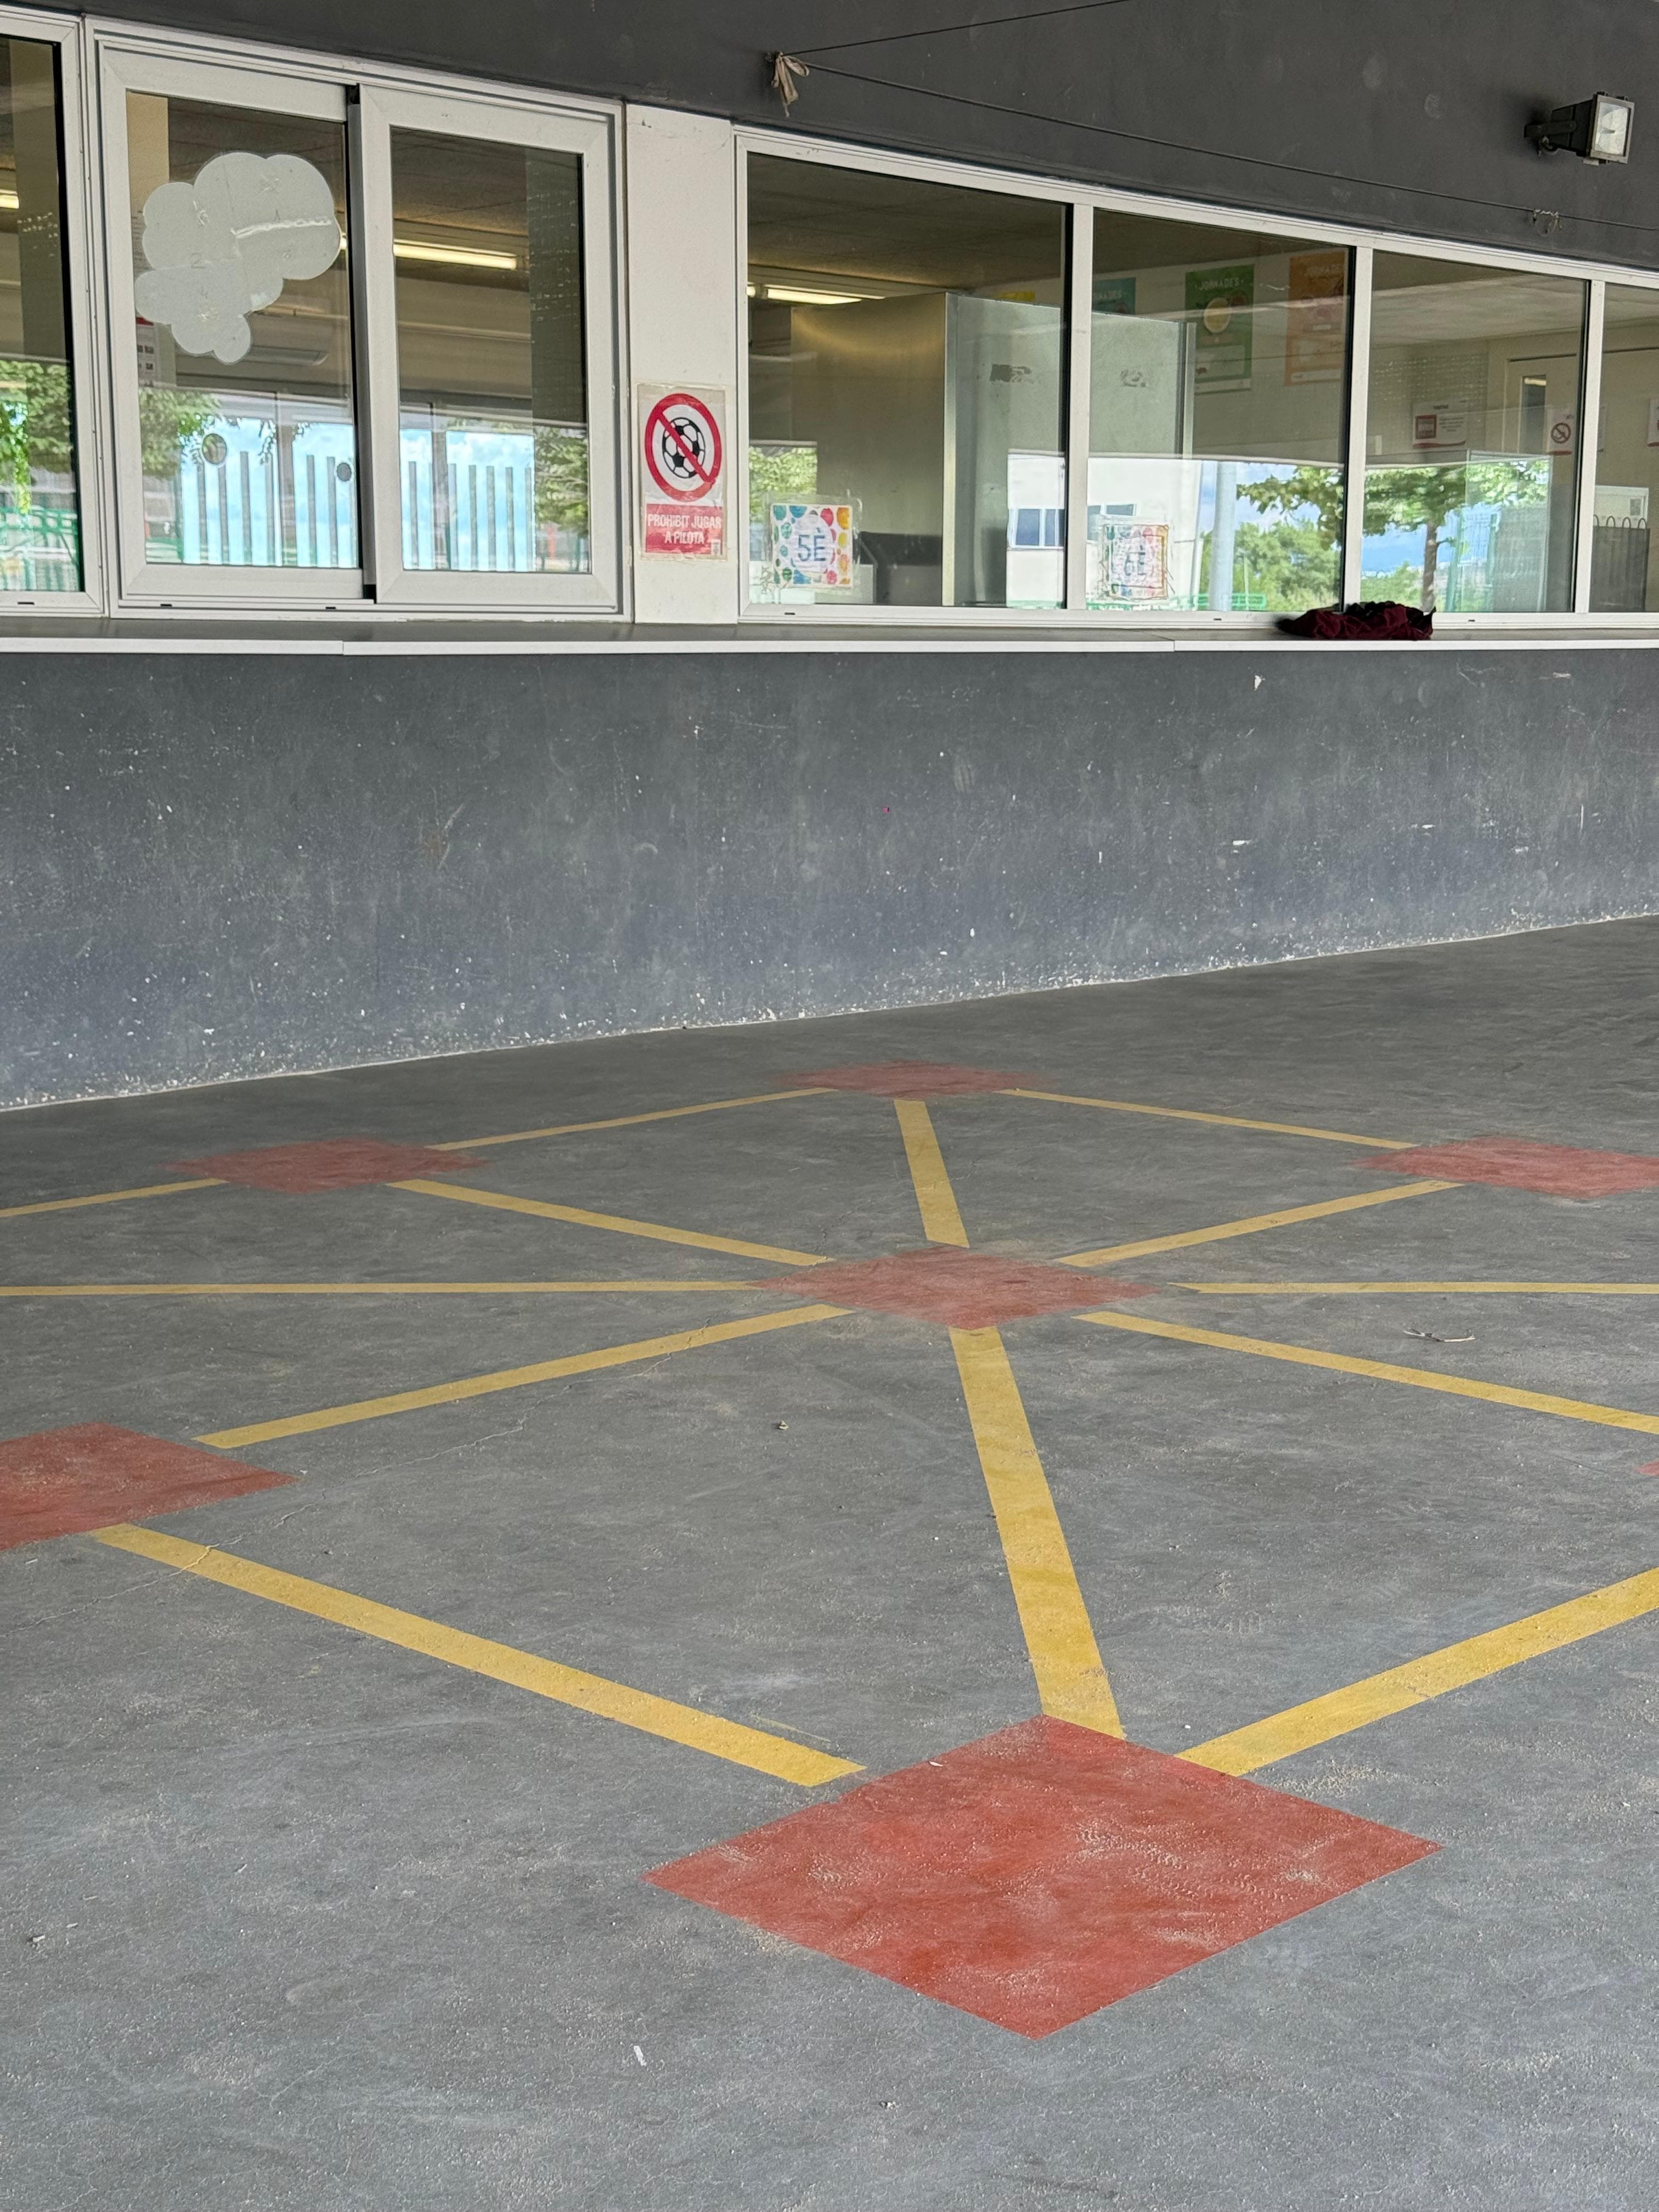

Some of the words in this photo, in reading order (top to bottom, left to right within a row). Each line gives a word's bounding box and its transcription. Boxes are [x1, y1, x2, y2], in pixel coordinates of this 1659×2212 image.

[1198, 278, 1239, 290] JORNADES
[647, 514, 690, 527] PROHIBIT
[691, 515, 721, 528] JUGAR
[664, 531, 673, 544] A
[674, 531, 705, 544] PILOTA
